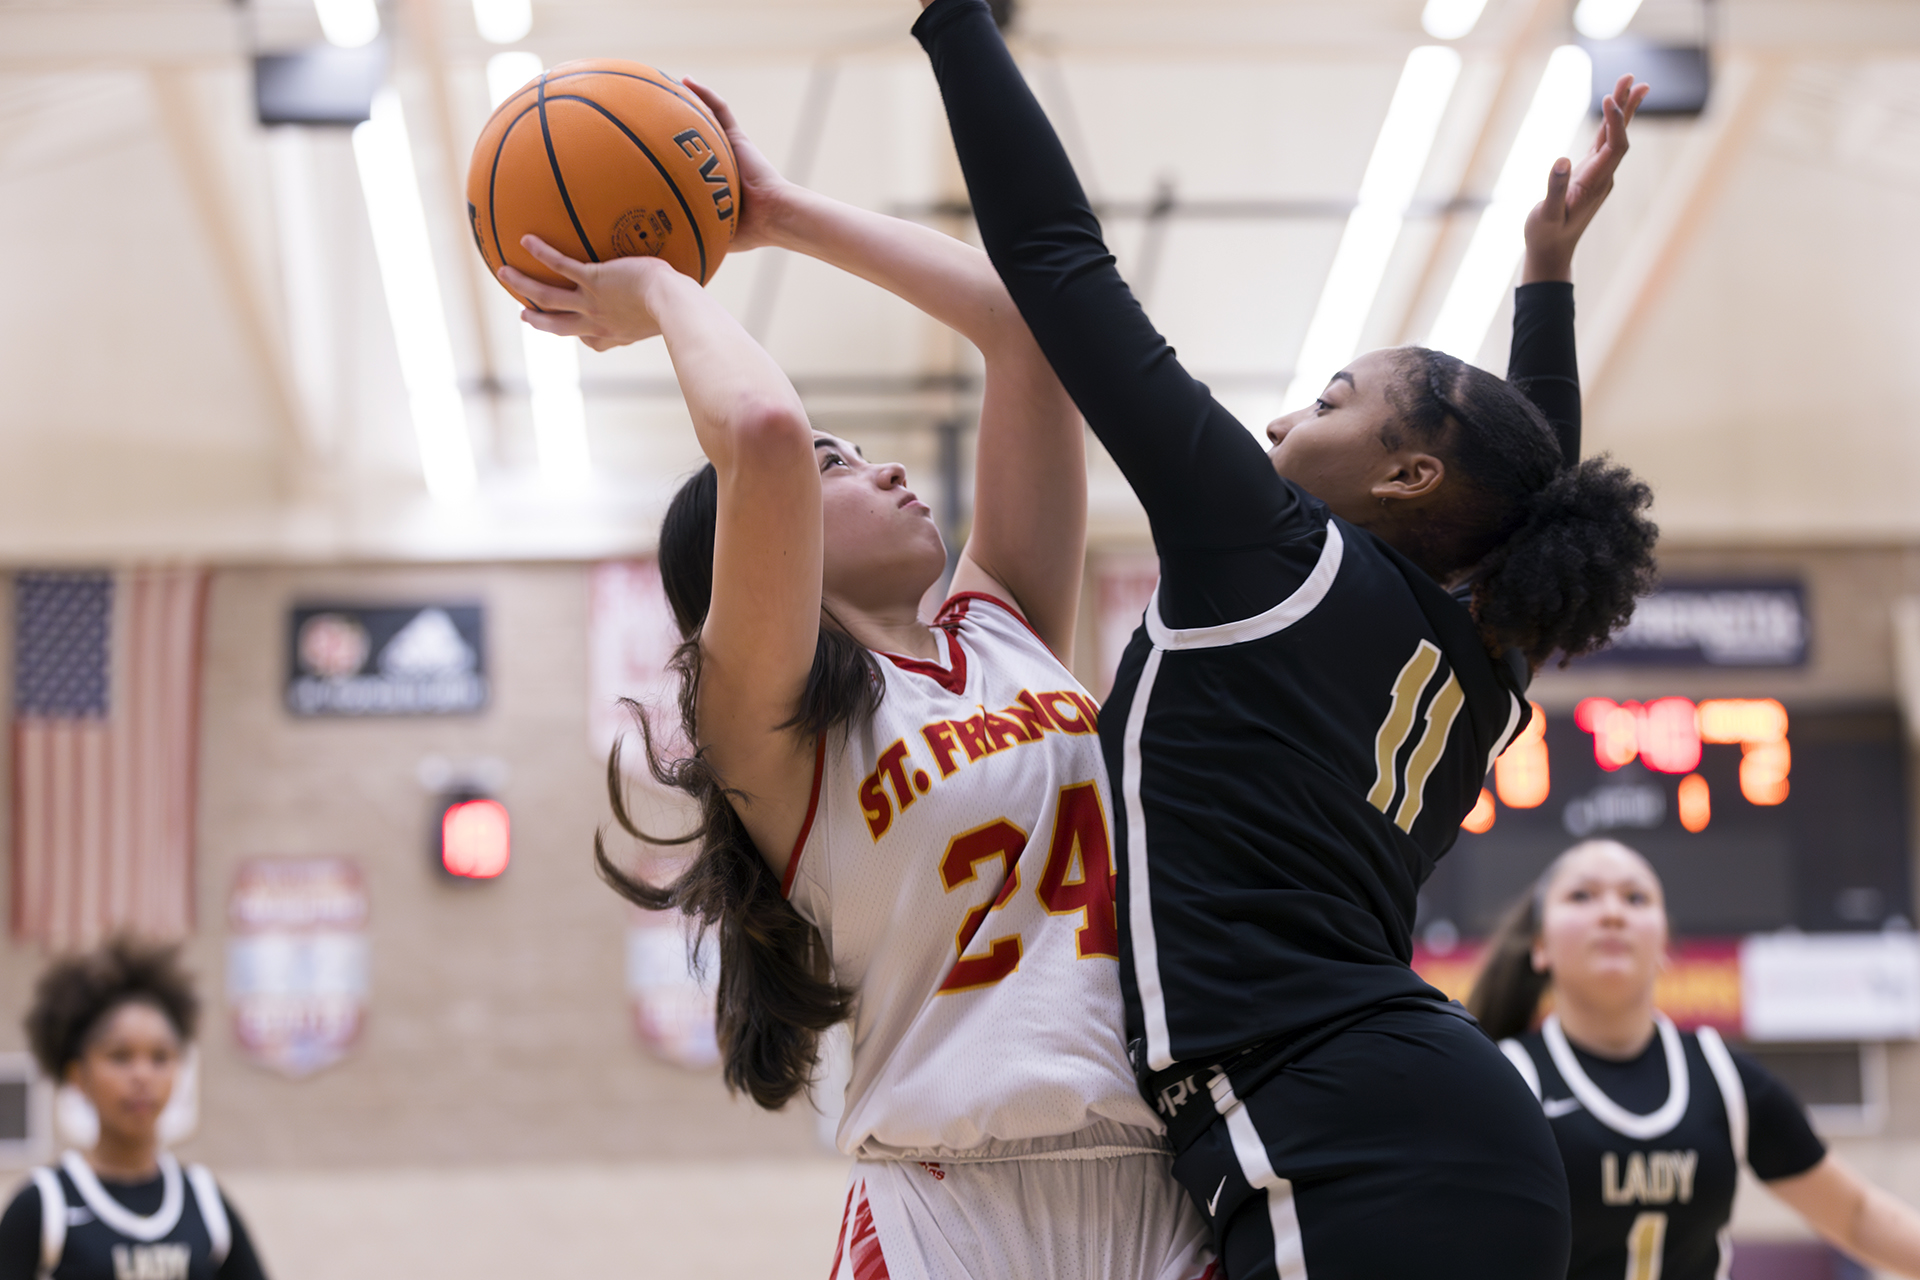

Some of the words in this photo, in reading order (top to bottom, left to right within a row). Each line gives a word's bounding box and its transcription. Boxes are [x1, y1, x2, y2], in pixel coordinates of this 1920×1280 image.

[858, 737, 932, 844] ST.
[919, 688, 1100, 781] FRANCI
[1366, 638, 1466, 835] 11
[934, 779, 1119, 997] 24
[1601, 1149, 1699, 1206] LADY
[1624, 1211, 1669, 1280] 1
